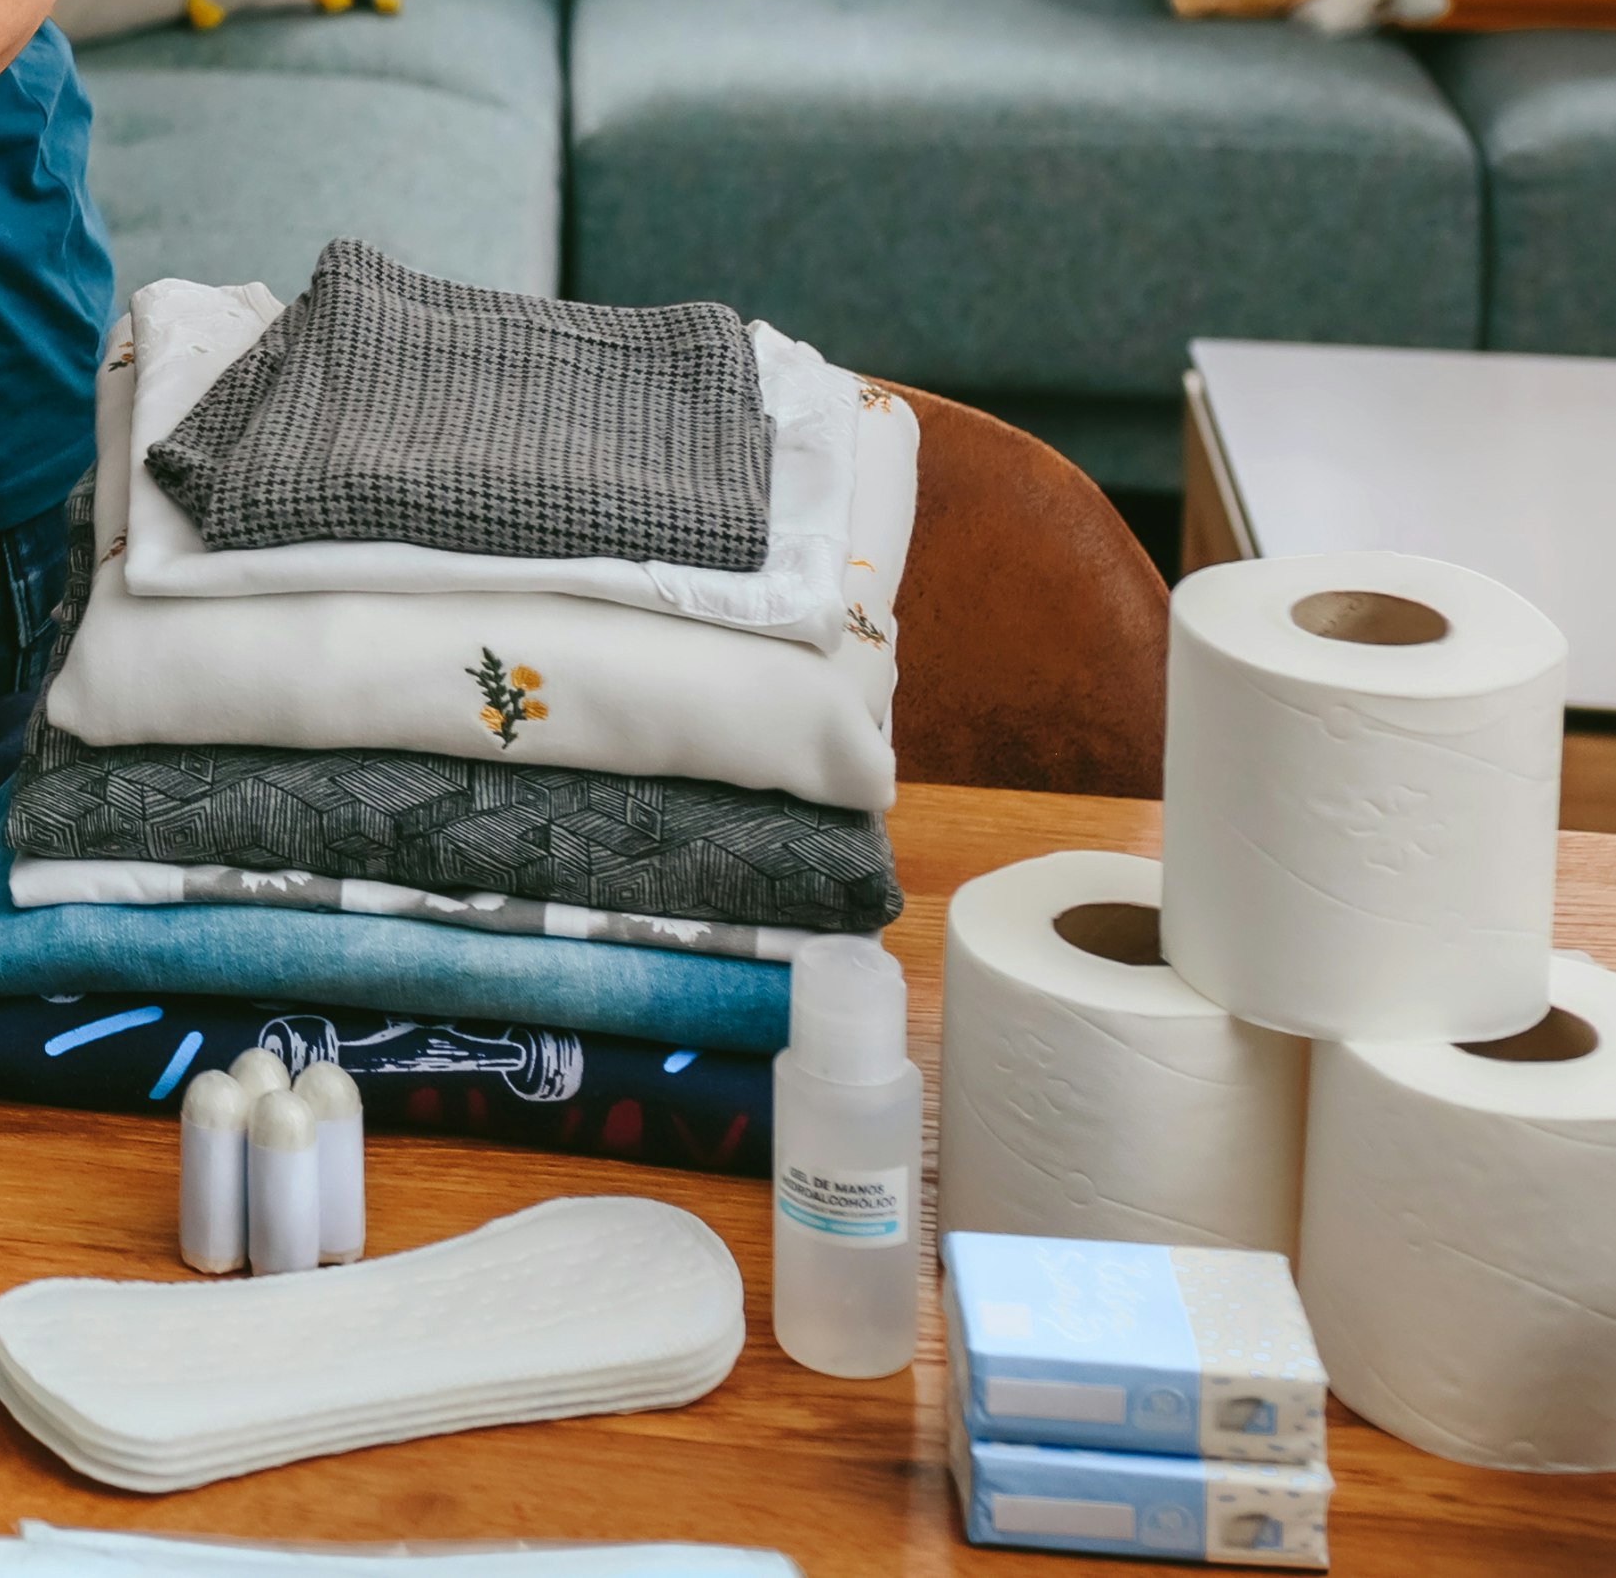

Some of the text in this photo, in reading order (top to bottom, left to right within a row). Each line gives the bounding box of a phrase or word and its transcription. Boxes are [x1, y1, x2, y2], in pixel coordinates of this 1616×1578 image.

[790, 1167, 884, 1196] GEL DE MANOS
